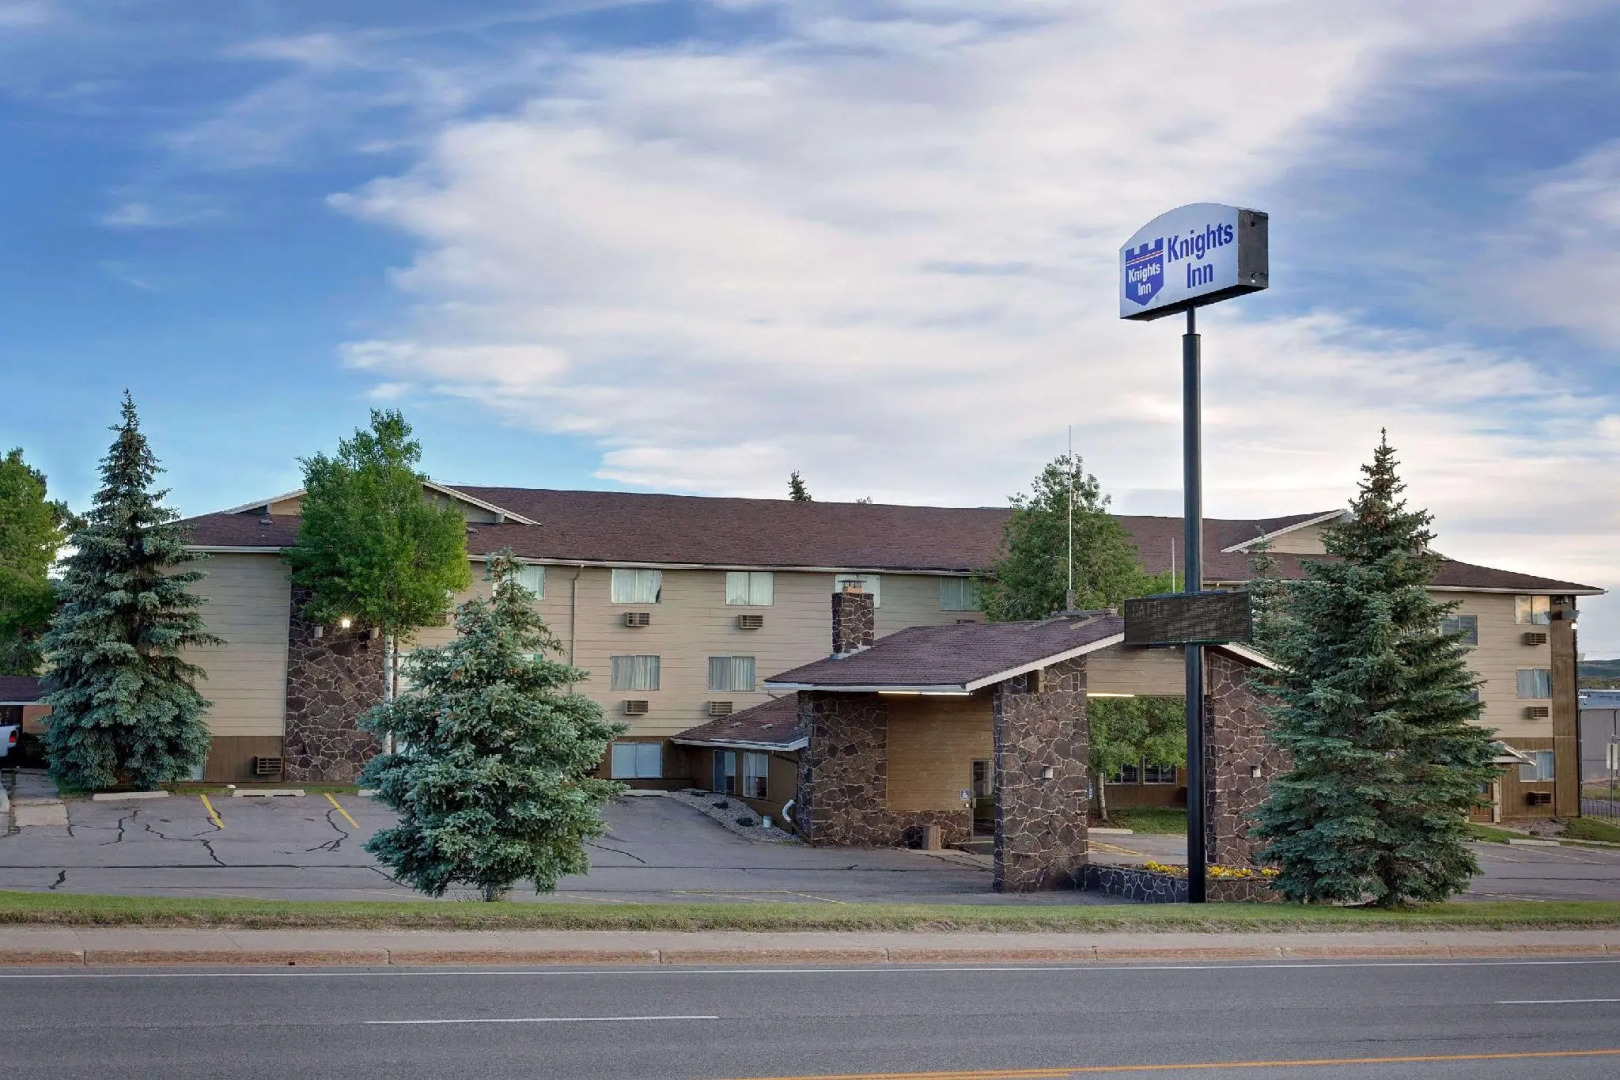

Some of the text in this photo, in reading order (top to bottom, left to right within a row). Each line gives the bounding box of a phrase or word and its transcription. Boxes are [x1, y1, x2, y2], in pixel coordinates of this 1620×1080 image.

[1168, 223, 1233, 263] Knights
[1128, 263, 1160, 282] Knights
[1187, 263, 1213, 288] Inn
[1138, 283, 1151, 296] Inn
